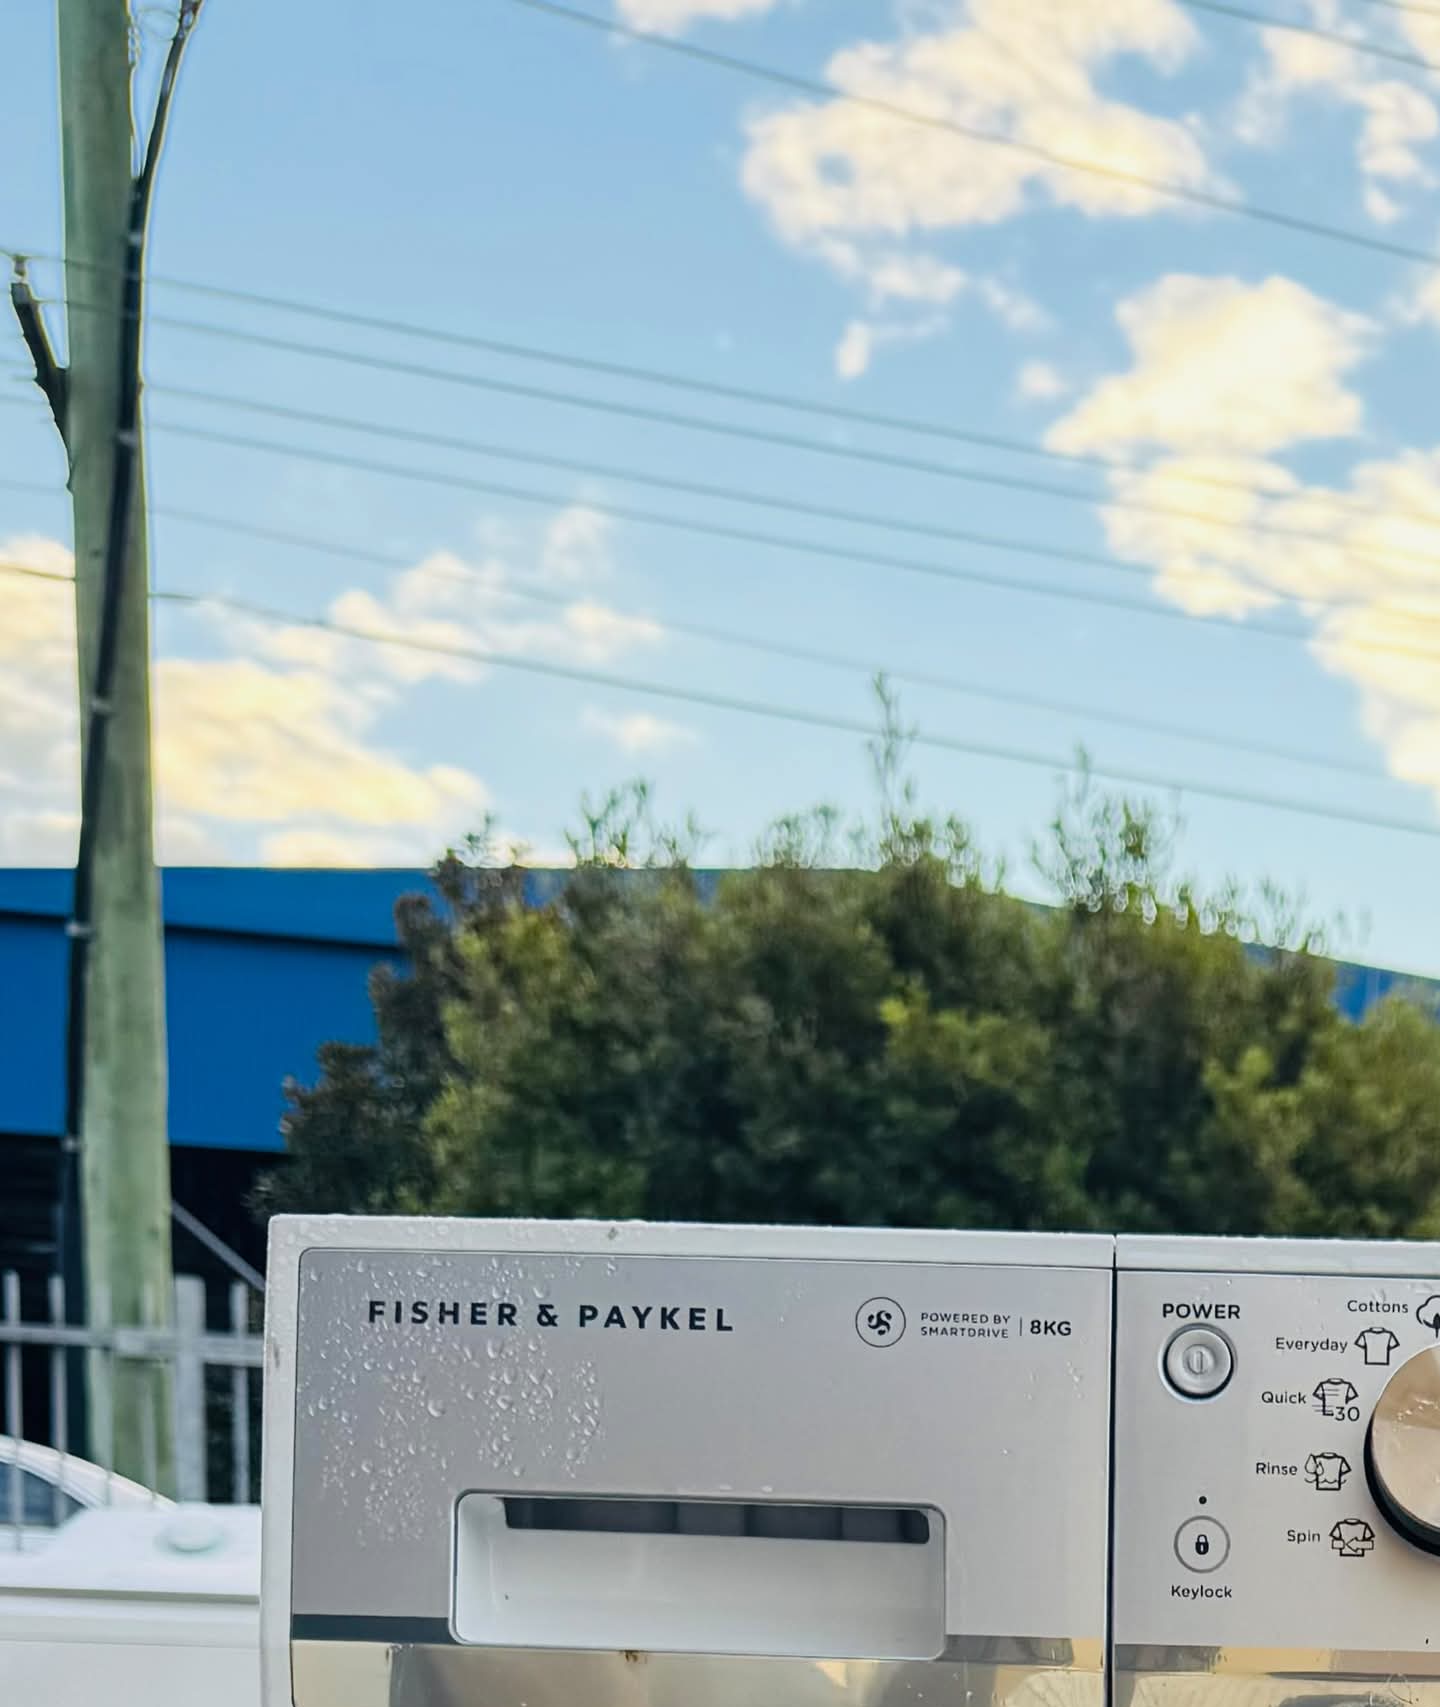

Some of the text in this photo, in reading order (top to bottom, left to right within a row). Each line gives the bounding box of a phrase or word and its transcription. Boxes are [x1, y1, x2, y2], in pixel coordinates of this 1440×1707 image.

[1162, 1303, 1241, 1320] POWER
[1347, 1300, 1409, 1314] Cottons
[368, 1300, 734, 1332] FISHER & PAYKEL
[920, 1312, 1011, 1325] POWERED BY
[920, 1327, 1009, 1339] SMARTDRIVE
[1029, 1319, 1072, 1336] 8KG
[1275, 1337, 1348, 1353] Everyday
[1261, 1391, 1307, 1405] Quick
[1334, 1406, 1361, 1422] 30
[1256, 1462, 1298, 1476] Rinse
[1287, 1530, 1321, 1545] Spin
[1171, 1585, 1232, 1601] Keylock
